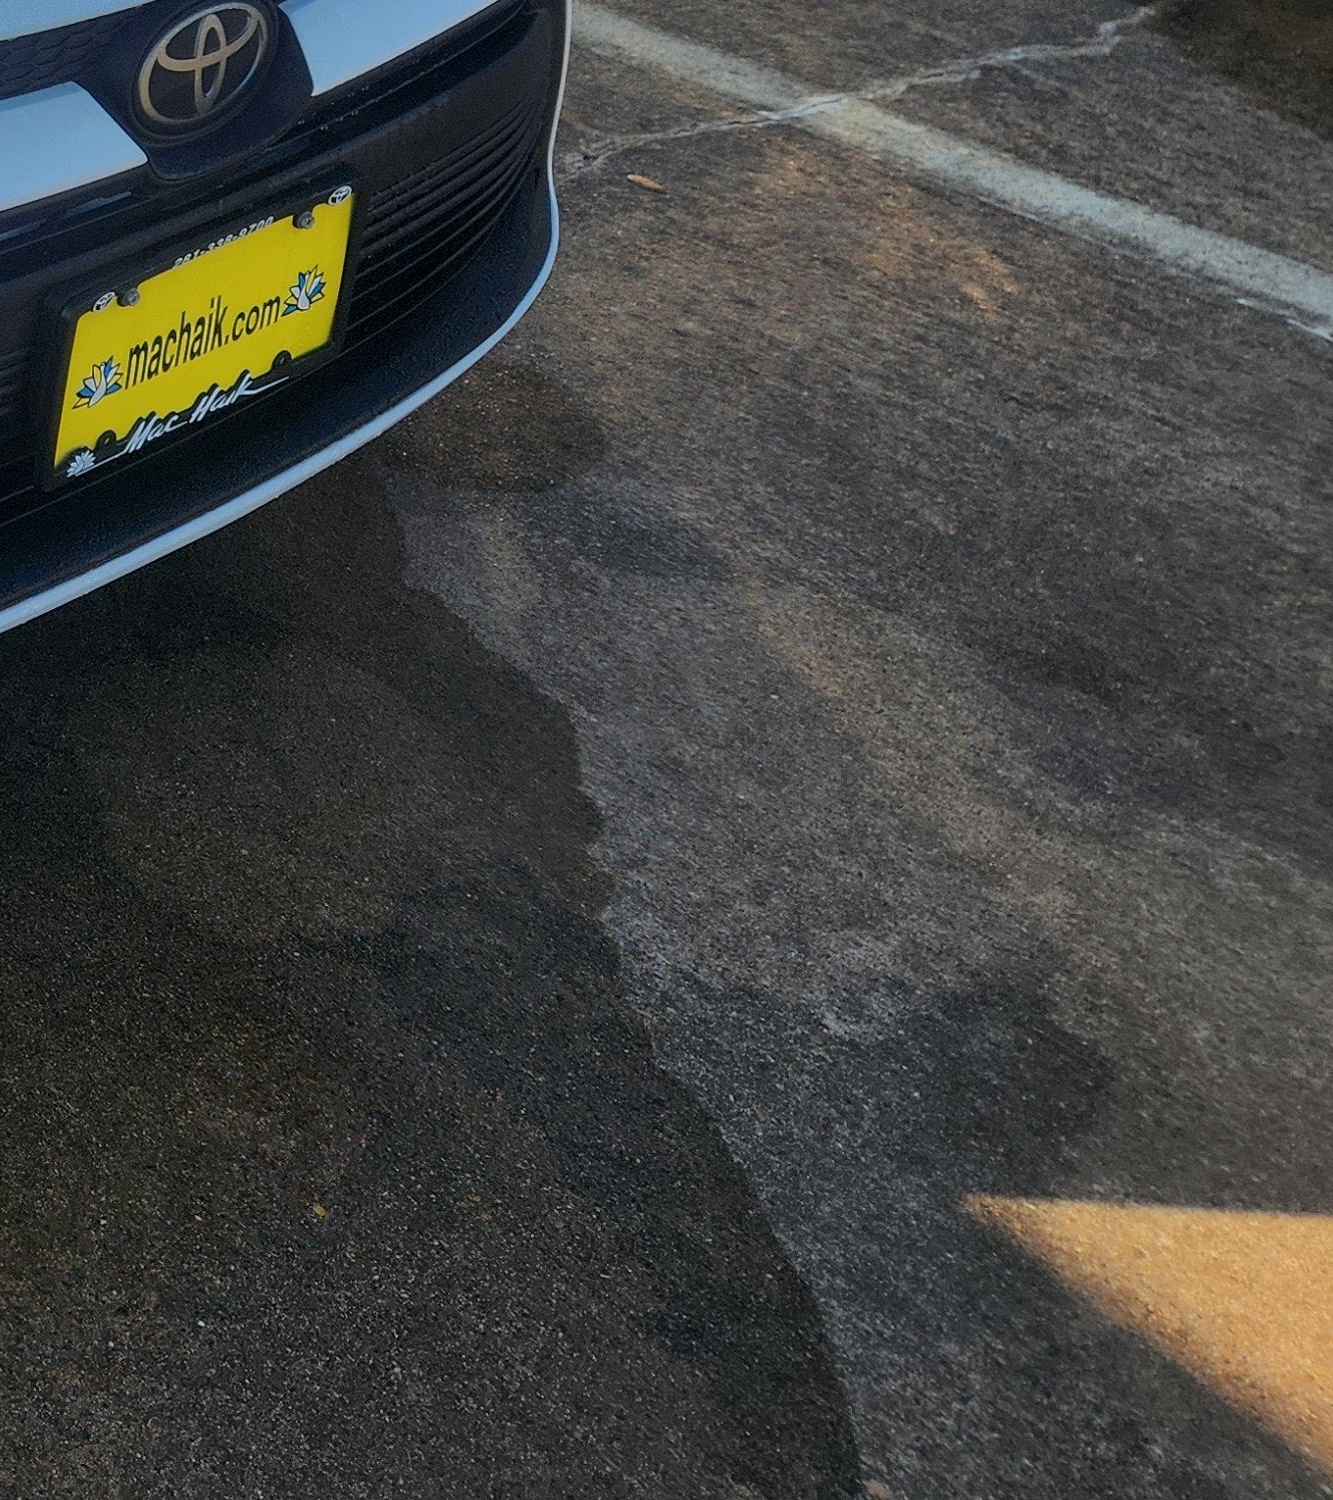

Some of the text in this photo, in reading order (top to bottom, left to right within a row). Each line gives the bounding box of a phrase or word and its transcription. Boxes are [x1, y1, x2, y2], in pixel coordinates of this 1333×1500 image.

[124, 295, 280, 389] machaik.com
[123, 374, 261, 453] Mac Haik
